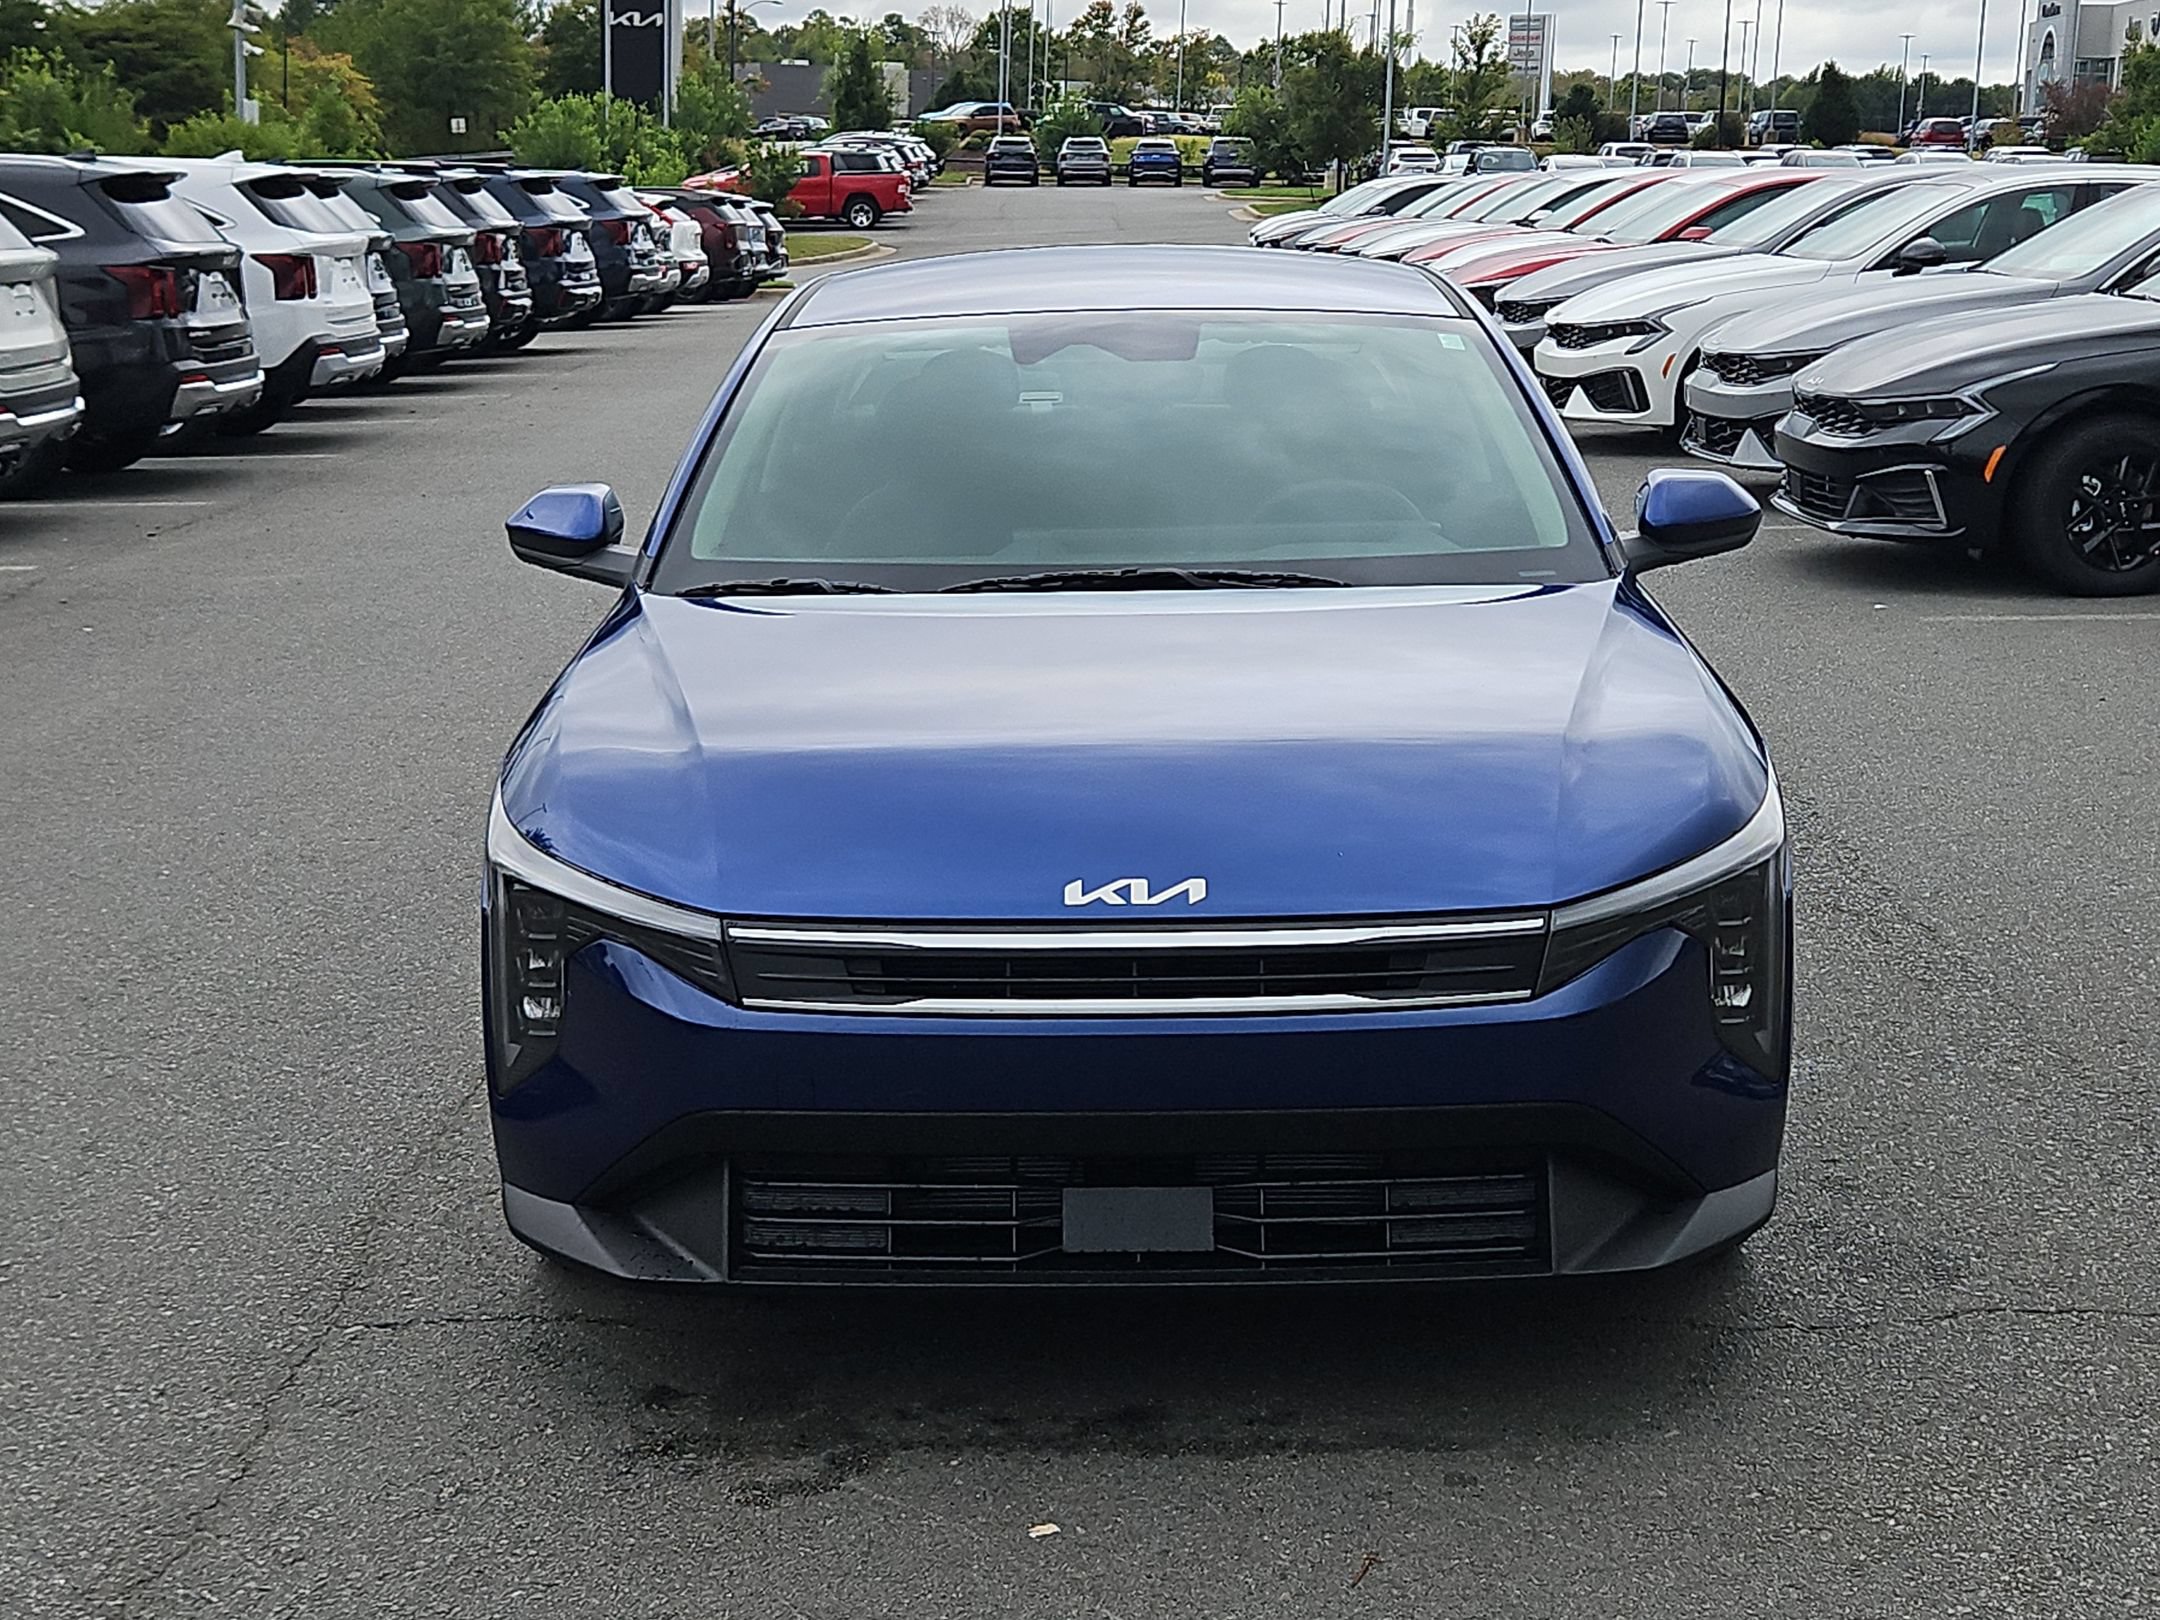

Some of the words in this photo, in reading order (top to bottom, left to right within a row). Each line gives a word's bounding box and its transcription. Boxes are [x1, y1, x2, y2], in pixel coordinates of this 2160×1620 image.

[609, 11, 664, 27] KIA
[1513, 48, 1535, 57] Jep
[1064, 878, 1207, 906] KIA
